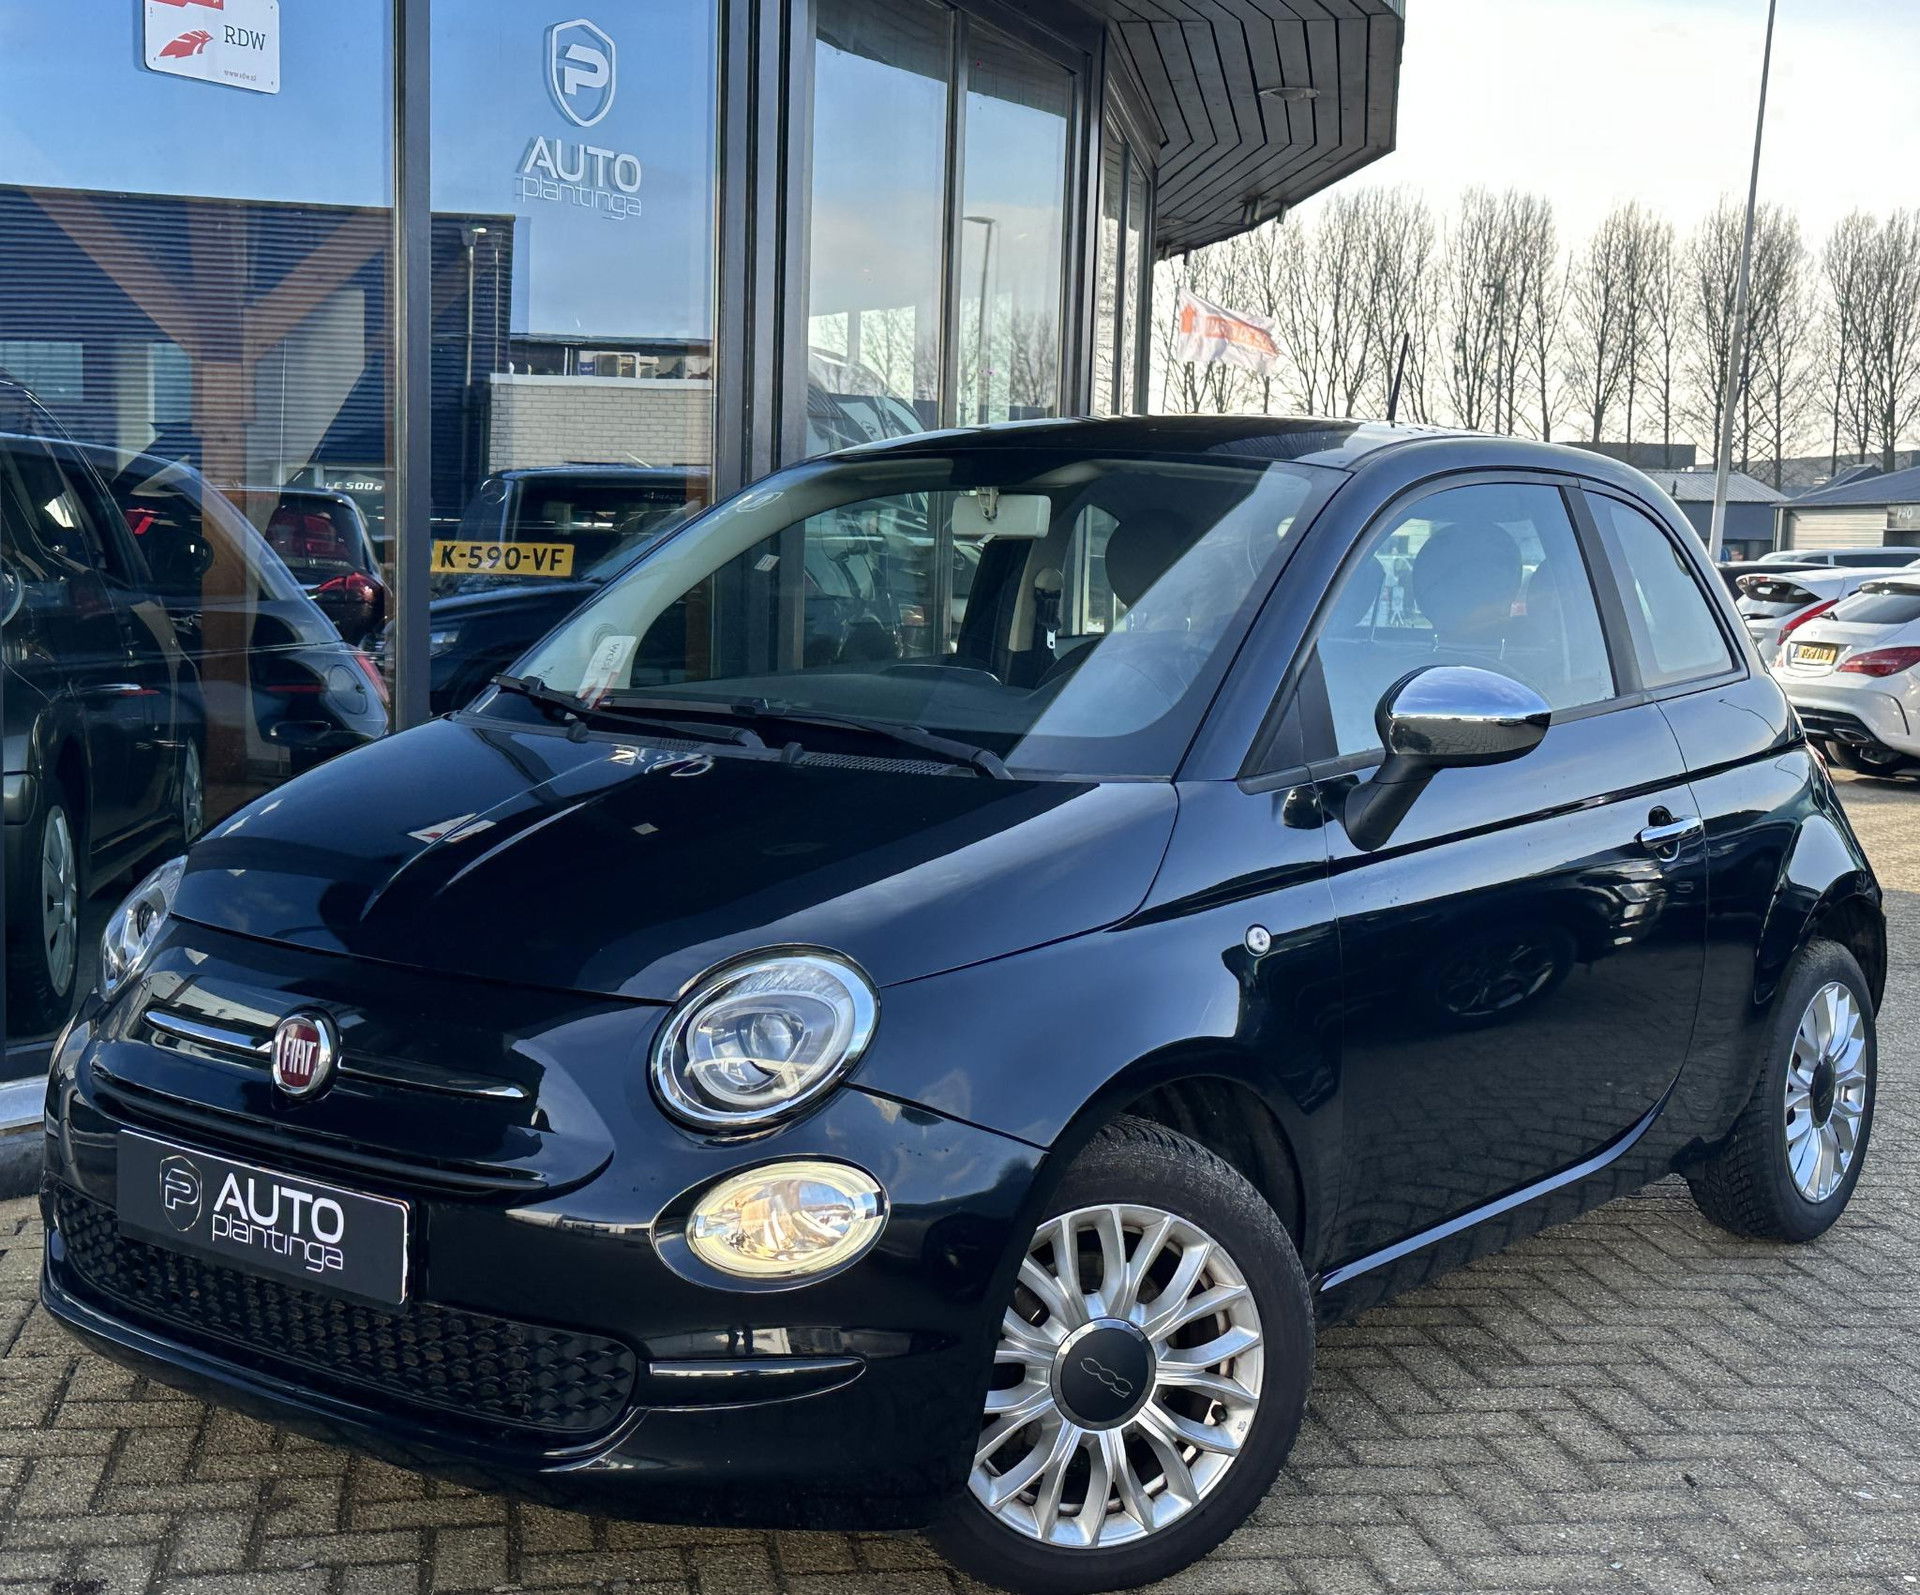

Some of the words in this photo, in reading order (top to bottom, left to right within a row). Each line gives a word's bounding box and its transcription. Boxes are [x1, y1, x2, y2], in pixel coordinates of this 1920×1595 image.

[224, 25, 266, 51] RDW
[564, 43, 610, 96] P
[524, 136, 642, 193] AUTO
[522, 175, 642, 221] plantinga
[440, 545, 565, 571] K-590-VF
[282, 1036, 317, 1076] FIAT
[165, 1168, 200, 1211] P
[213, 1172, 345, 1244] AUTO
[212, 1213, 344, 1273] plantinga
